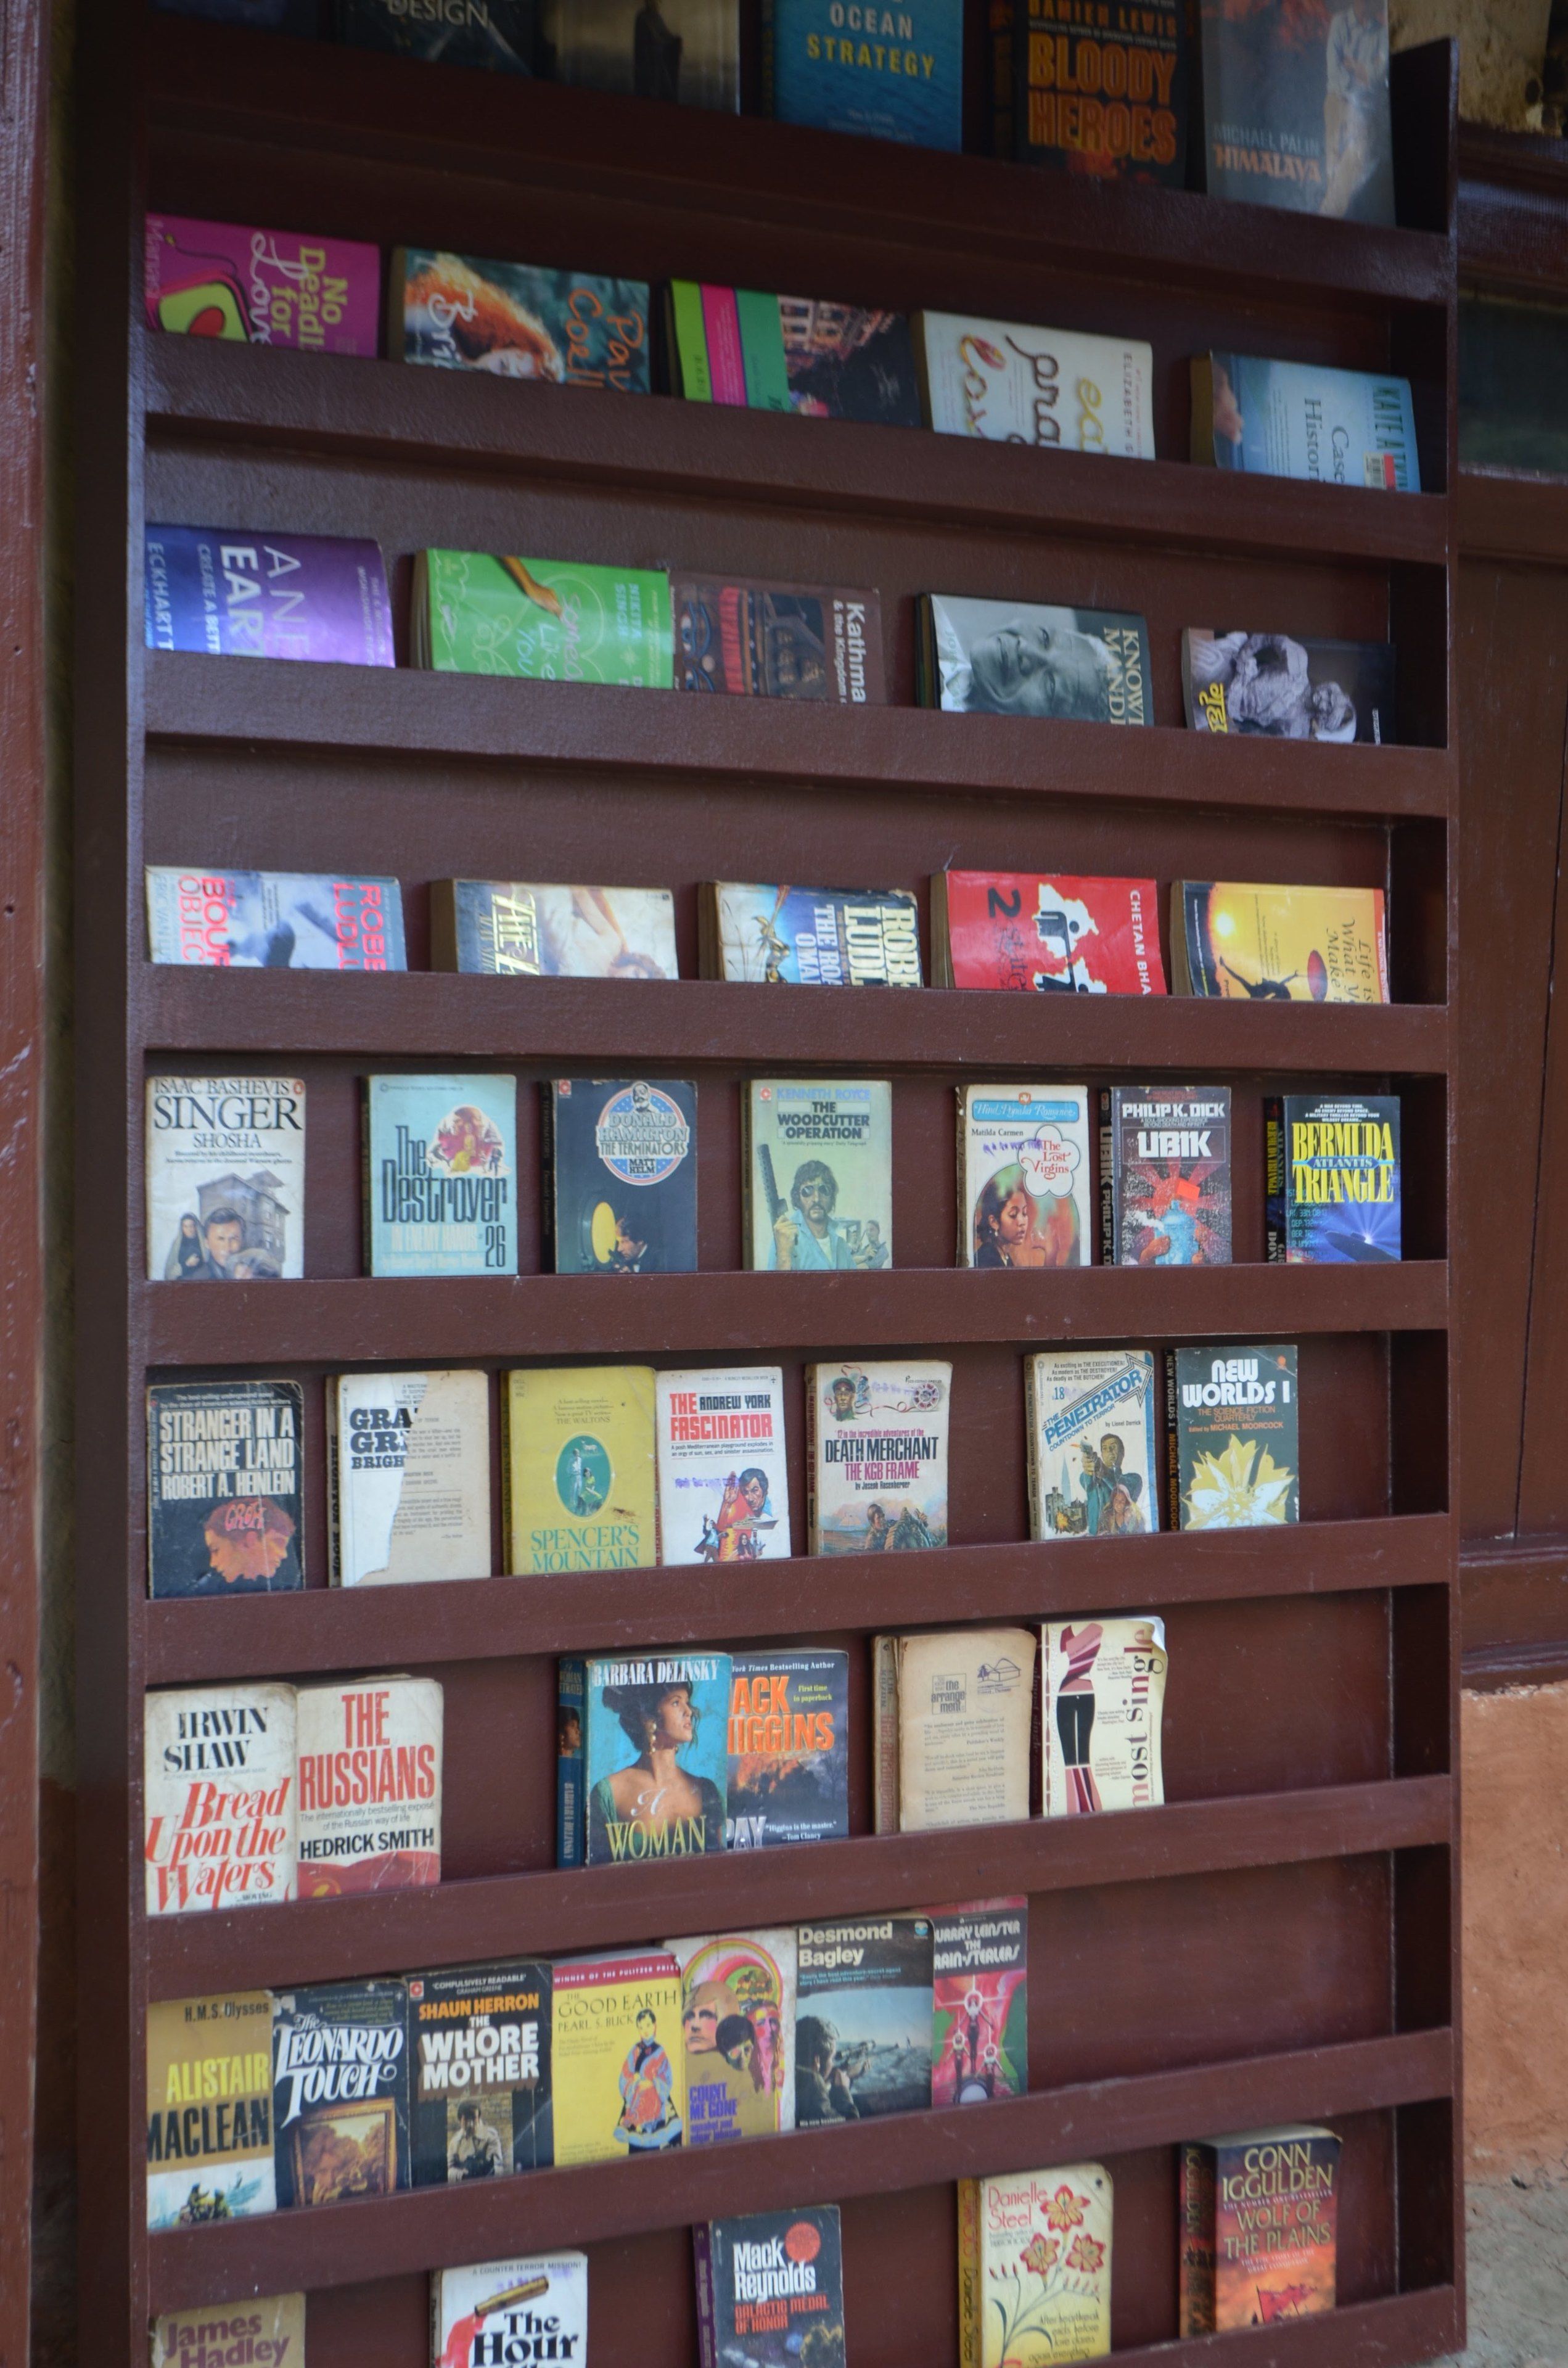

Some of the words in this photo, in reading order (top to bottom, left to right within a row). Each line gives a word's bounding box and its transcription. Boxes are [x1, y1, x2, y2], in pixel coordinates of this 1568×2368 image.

[829, 1, 914, 39] OCEAN
[807, 33, 935, 80] STRATEGY
[1027, 31, 1176, 104] BLOODY
[1027, 88, 1177, 165] HEROES
[1216, 125, 1275, 149] MICHAEL
[1213, 143, 1322, 183] HIMALAYA
[270, 285, 298, 339] for
[321, 276, 348, 324] No
[1372, 385, 1404, 435] KATE
[1331, 425, 1350, 483] Case
[263, 545, 302, 579] A
[147, 542, 172, 636] ECKHART
[615, 583, 629, 639] SINGH
[628, 583, 643, 639] NIKITA
[833, 618, 844, 637] the
[834, 638, 848, 699] Kingdom
[847, 602, 866, 704] Kathma
[1130, 889, 1145, 956] CHETAN
[1326, 927, 1345, 989] Make
[1341, 916, 1357, 976] What
[1358, 939, 1374, 980] Life
[154, 1079, 202, 1095] ISAAC
[207, 1080, 290, 1095] BASHEVIS
[154, 1096, 303, 1130] SINGER
[609, 1112, 678, 1128] DONALD
[778, 1114, 871, 1127] WOODCUTTER
[811, 1101, 837, 1113] THE
[1122, 1103, 1172, 1119] PHILIP
[1173, 1103, 1188, 1117] K.
[1189, 1103, 1226, 1117] DICK
[193, 1132, 263, 1149] SHOSHA
[598, 1127, 689, 1142] HAMILTON
[601, 1142, 616, 1156] THE
[618, 1142, 686, 1157] TERMINATORS
[786, 1127, 862, 1140] OPERATION
[971, 1128, 996, 1137] Matilda
[998, 1128, 1024, 1137] Carmen
[1136, 1130, 1212, 1158] UBIK
[1291, 1122, 1395, 1161] BERMUDA
[629, 1158, 655, 1167] MATT
[1312, 1157, 1373, 1168] ATLANTIS
[382, 1159, 509, 1223] Destroyer
[1291, 1164, 1394, 1203] TRIANGLE
[669, 1392, 698, 1416] THE
[699, 1394, 741, 1411] ANDREW
[745, 1394, 771, 1409] YORK
[1044, 1368, 1143, 1445] PENETRATOR
[1198, 1408, 1213, 1416] THE
[1213, 1407, 1245, 1416] SCIENCE
[1246, 1405, 1276, 1415] FICTION
[160, 1408, 252, 1442] STRANGER
[255, 1408, 276, 1438] IN
[279, 1407, 295, 1437] A
[670, 1413, 774, 1442] FASCINATOR
[160, 1439, 240, 1474] STRANGE
[246, 1438, 295, 1470] LAND
[825, 1438, 864, 1463] DEATH
[866, 1436, 939, 1462] MERCHANT
[160, 1473, 215, 1500] ROBERT
[216, 1472, 234, 1497] A.
[235, 1470, 296, 1496] HEINLEIN
[845, 1463, 863, 1481] THE
[864, 1462, 883, 1481] KGB
[885, 1461, 920, 1480] FRAME
[532, 1547, 639, 1573] MOUNTAIN
[591, 1662, 654, 1687] BARBARA
[656, 1659, 720, 1684] DELINSKY
[179, 1706, 269, 1740] IRWIN
[341, 1691, 391, 1749] THE
[163, 1740, 250, 1774] SHAW
[299, 1743, 436, 1812] RUSSIANS
[179, 1777, 292, 1831] Bread
[300, 1814, 314, 1823] The
[315, 1807, 366, 1820] internationally
[367, 1804, 406, 1817] bestselling
[323, 1822, 330, 1831] of
[331, 1821, 343, 1830] the
[344, 1818, 373, 1828] Russian
[374, 1817, 390, 1827] way
[390, 1814, 398, 1823] of
[398, 1814, 411, 1822] life
[144, 1814, 236, 1873] Upon
[236, 1818, 288, 1860] the
[300, 1832, 375, 1860] HEDRICK
[378, 1827, 435, 1851] SMITH
[605, 1815, 707, 1865] WOMAN
[155, 1860, 276, 1913] Waters
[798, 1922, 893, 1946] Desmond
[798, 1947, 864, 1969] Bagley
[184, 2005, 222, 2023] H.M.S.
[224, 2002, 269, 2021] Ulysses
[419, 1999, 472, 2021] SHAUN
[474, 1992, 540, 2015] HERRON
[558, 1997, 617, 2018] GOOD
[623, 1989, 677, 2010] EARTH
[469, 2015, 490, 2028] THE
[273, 2021, 404, 2087] LEONARDO
[421, 2021, 540, 2063] WHORE
[166, 2052, 269, 2104] ALISTAIR
[422, 2052, 540, 2092] MOTHER
[280, 2062, 398, 2129] TOUCH
[1244, 2142, 1311, 2174] CONN
[987, 2182, 1049, 2208] Danielle
[1222, 2163, 1334, 2202] IGGULDEN
[988, 2204, 1032, 2231] Steel
[1236, 2204, 1291, 2232] WOLF
[1295, 2198, 1321, 2221] OF
[733, 2235, 788, 2272] Mack
[1223, 2233, 1259, 2260] THE
[1266, 2221, 1332, 2253] PLAINS
[734, 2260, 817, 2303] Reynolds
[164, 2314, 263, 2359] James
[504, 2311, 560, 2336] The
[735, 2318, 748, 2336] OF
[751, 2312, 789, 2333] HONOR
[472, 2331, 579, 2368] Hour
